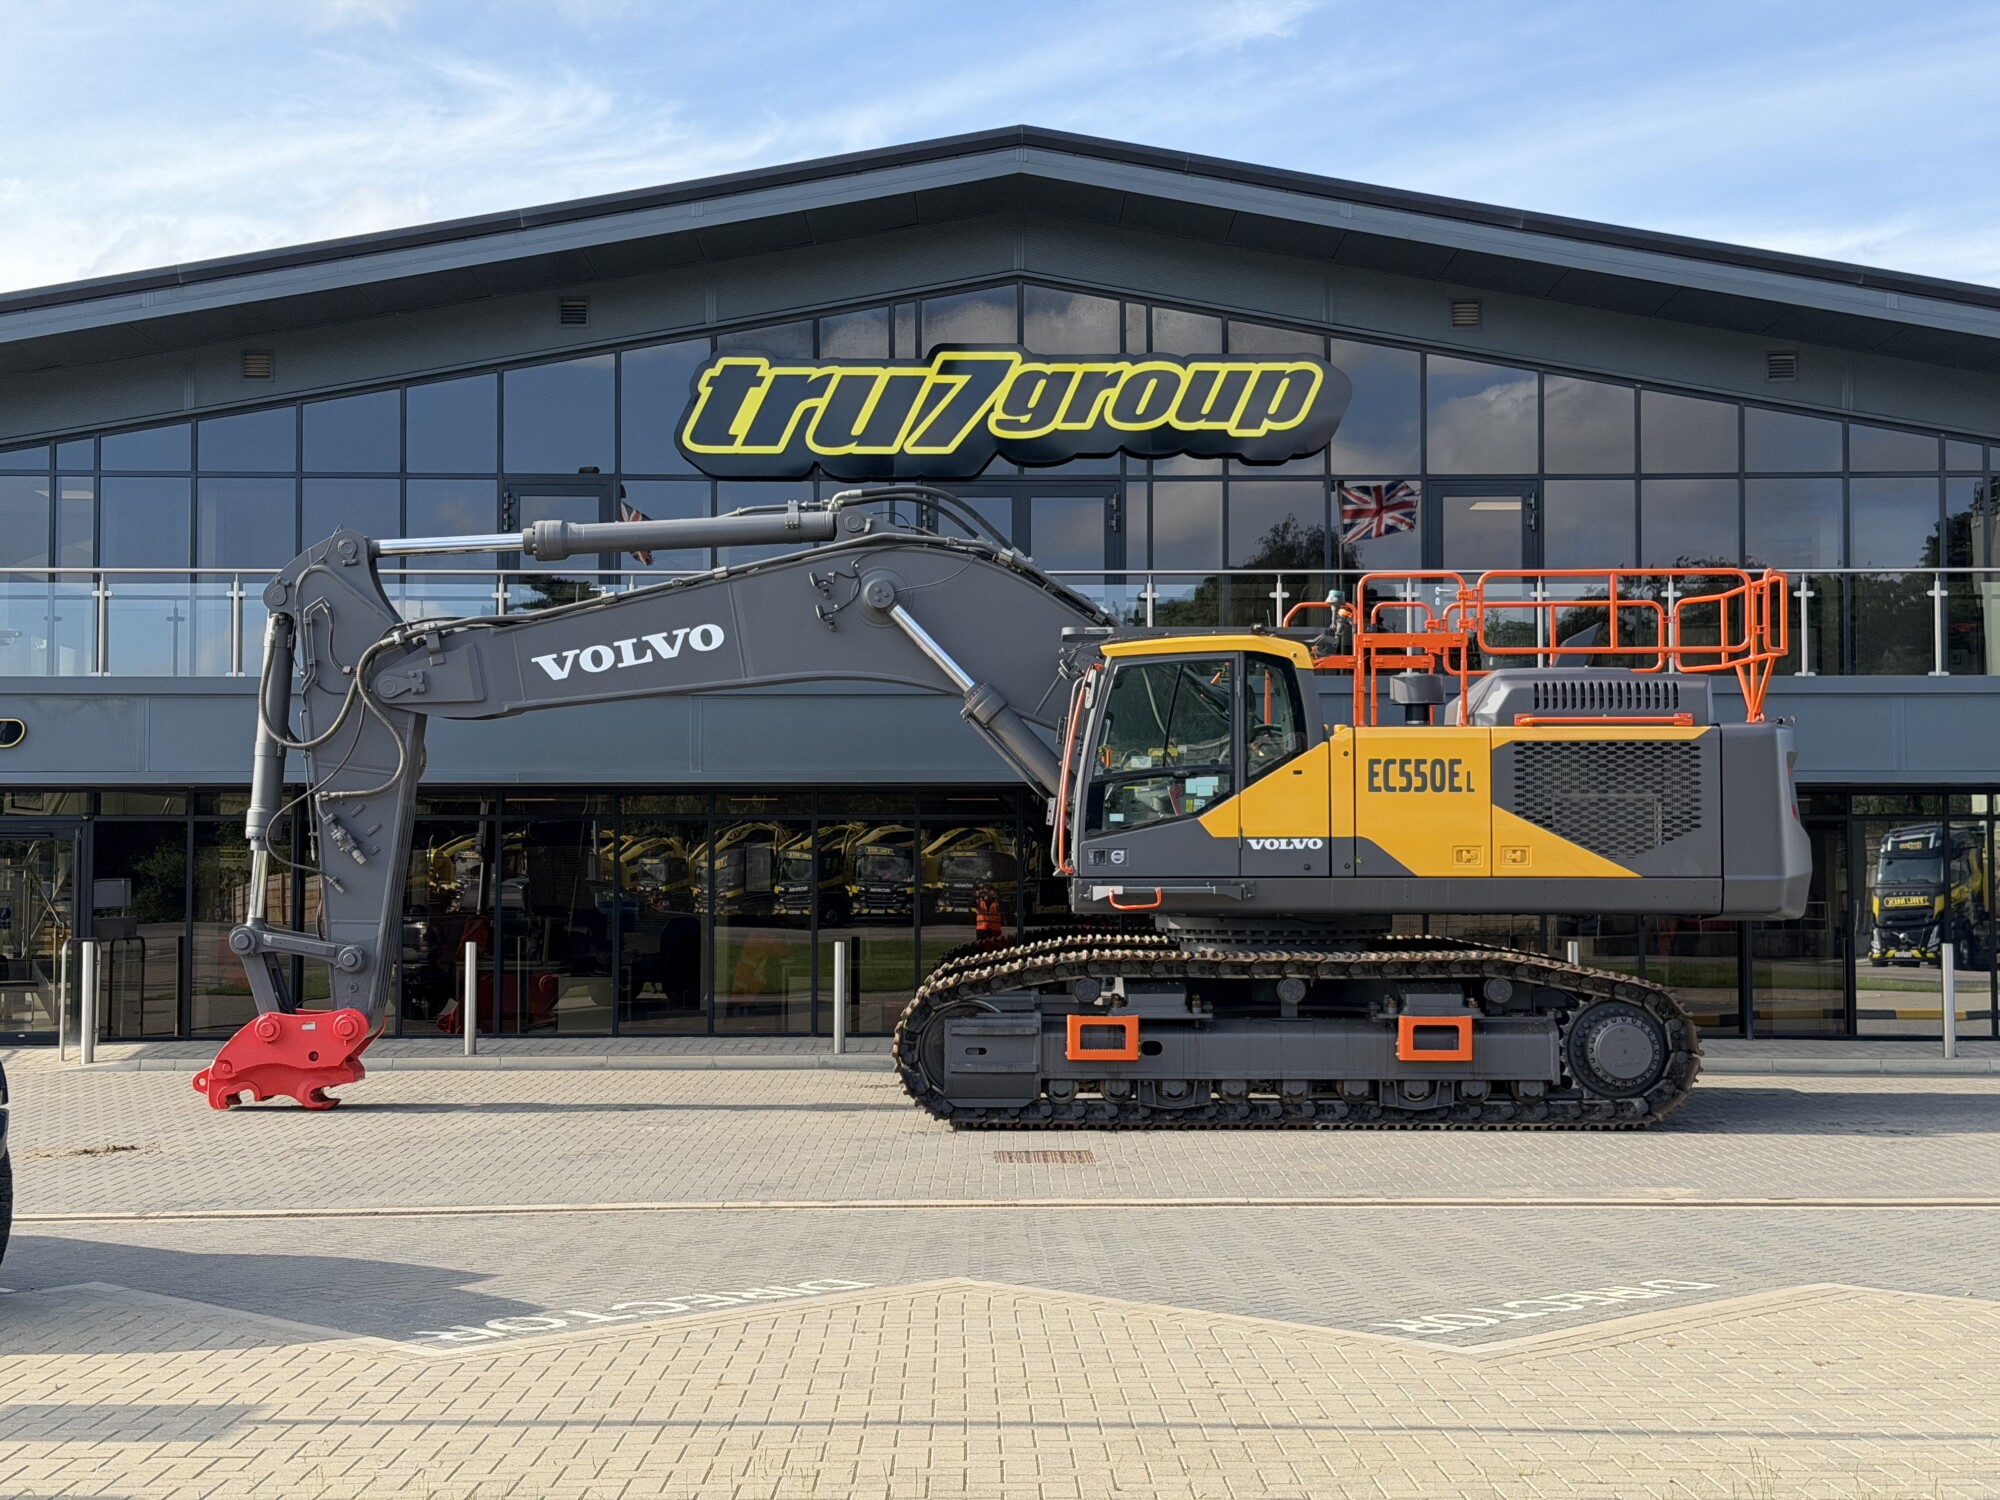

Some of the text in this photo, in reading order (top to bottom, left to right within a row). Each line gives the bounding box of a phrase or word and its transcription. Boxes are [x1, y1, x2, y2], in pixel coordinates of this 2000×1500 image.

[530, 623, 725, 681] VOLVO
[1246, 837, 1324, 850] VOLVO
[411, 1278, 875, 1342] DIRECTOR
[1368, 1278, 1720, 1335] DIRECTOR
